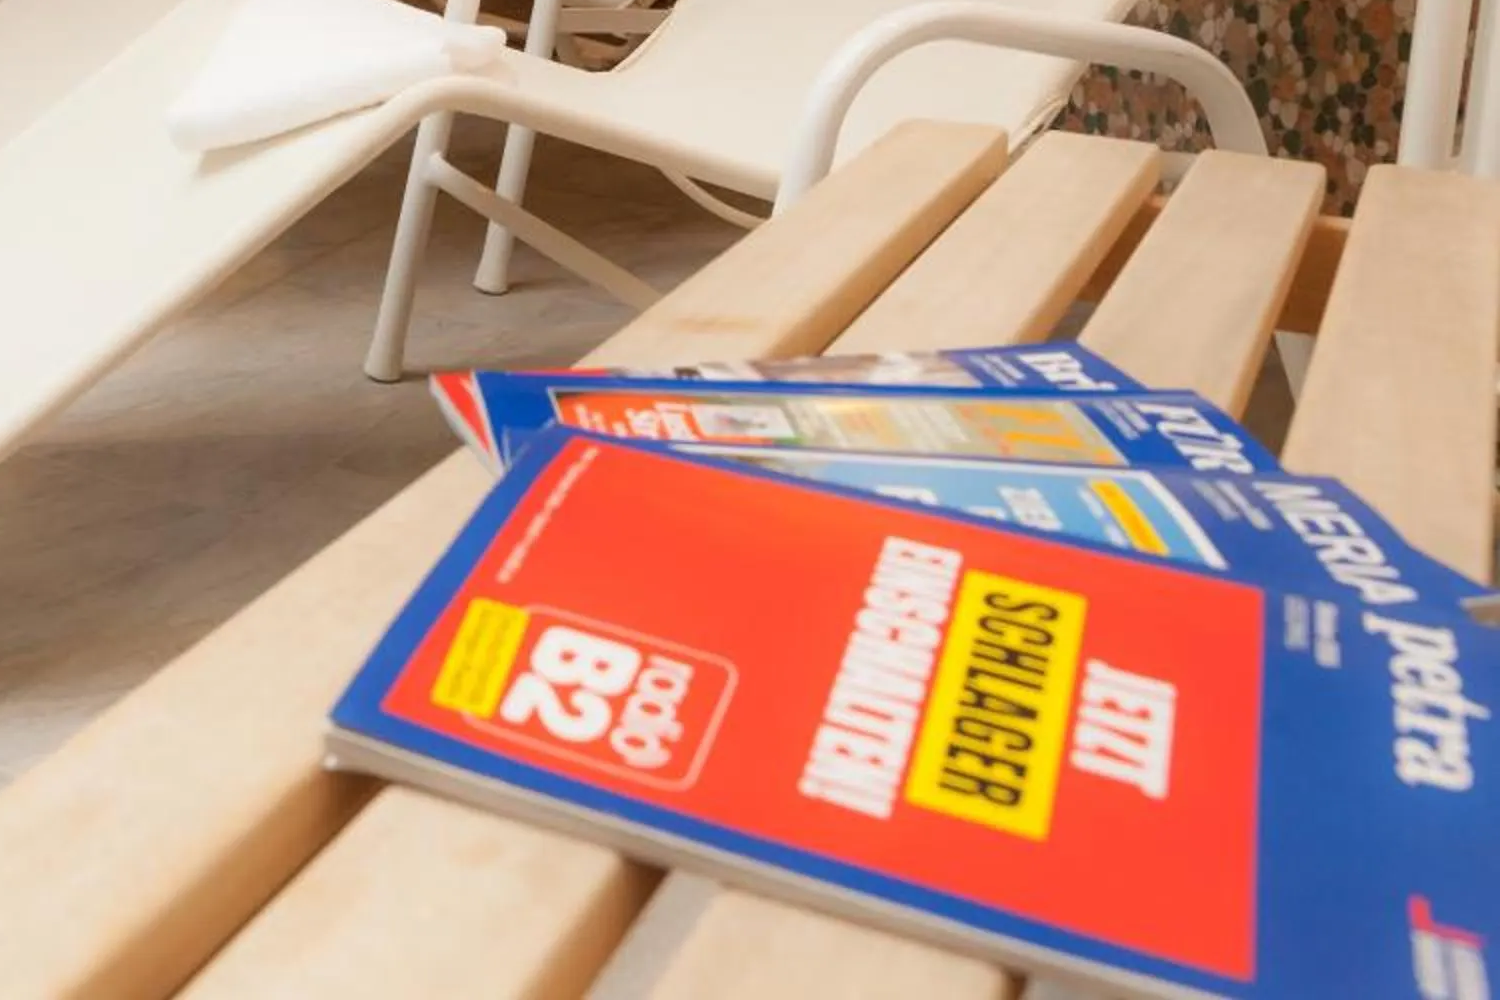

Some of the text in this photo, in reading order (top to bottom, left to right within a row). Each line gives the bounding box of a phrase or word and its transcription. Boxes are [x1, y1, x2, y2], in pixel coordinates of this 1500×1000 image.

[500, 626, 642, 742] B2
[610, 655, 694, 767] radio
[798, 535, 963, 819] EINSCHALTEN!
[937, 593, 1058, 808] SCHLAGER
[1069, 659, 1178, 799] JETZT
[1363, 613, 1491, 791] petra
